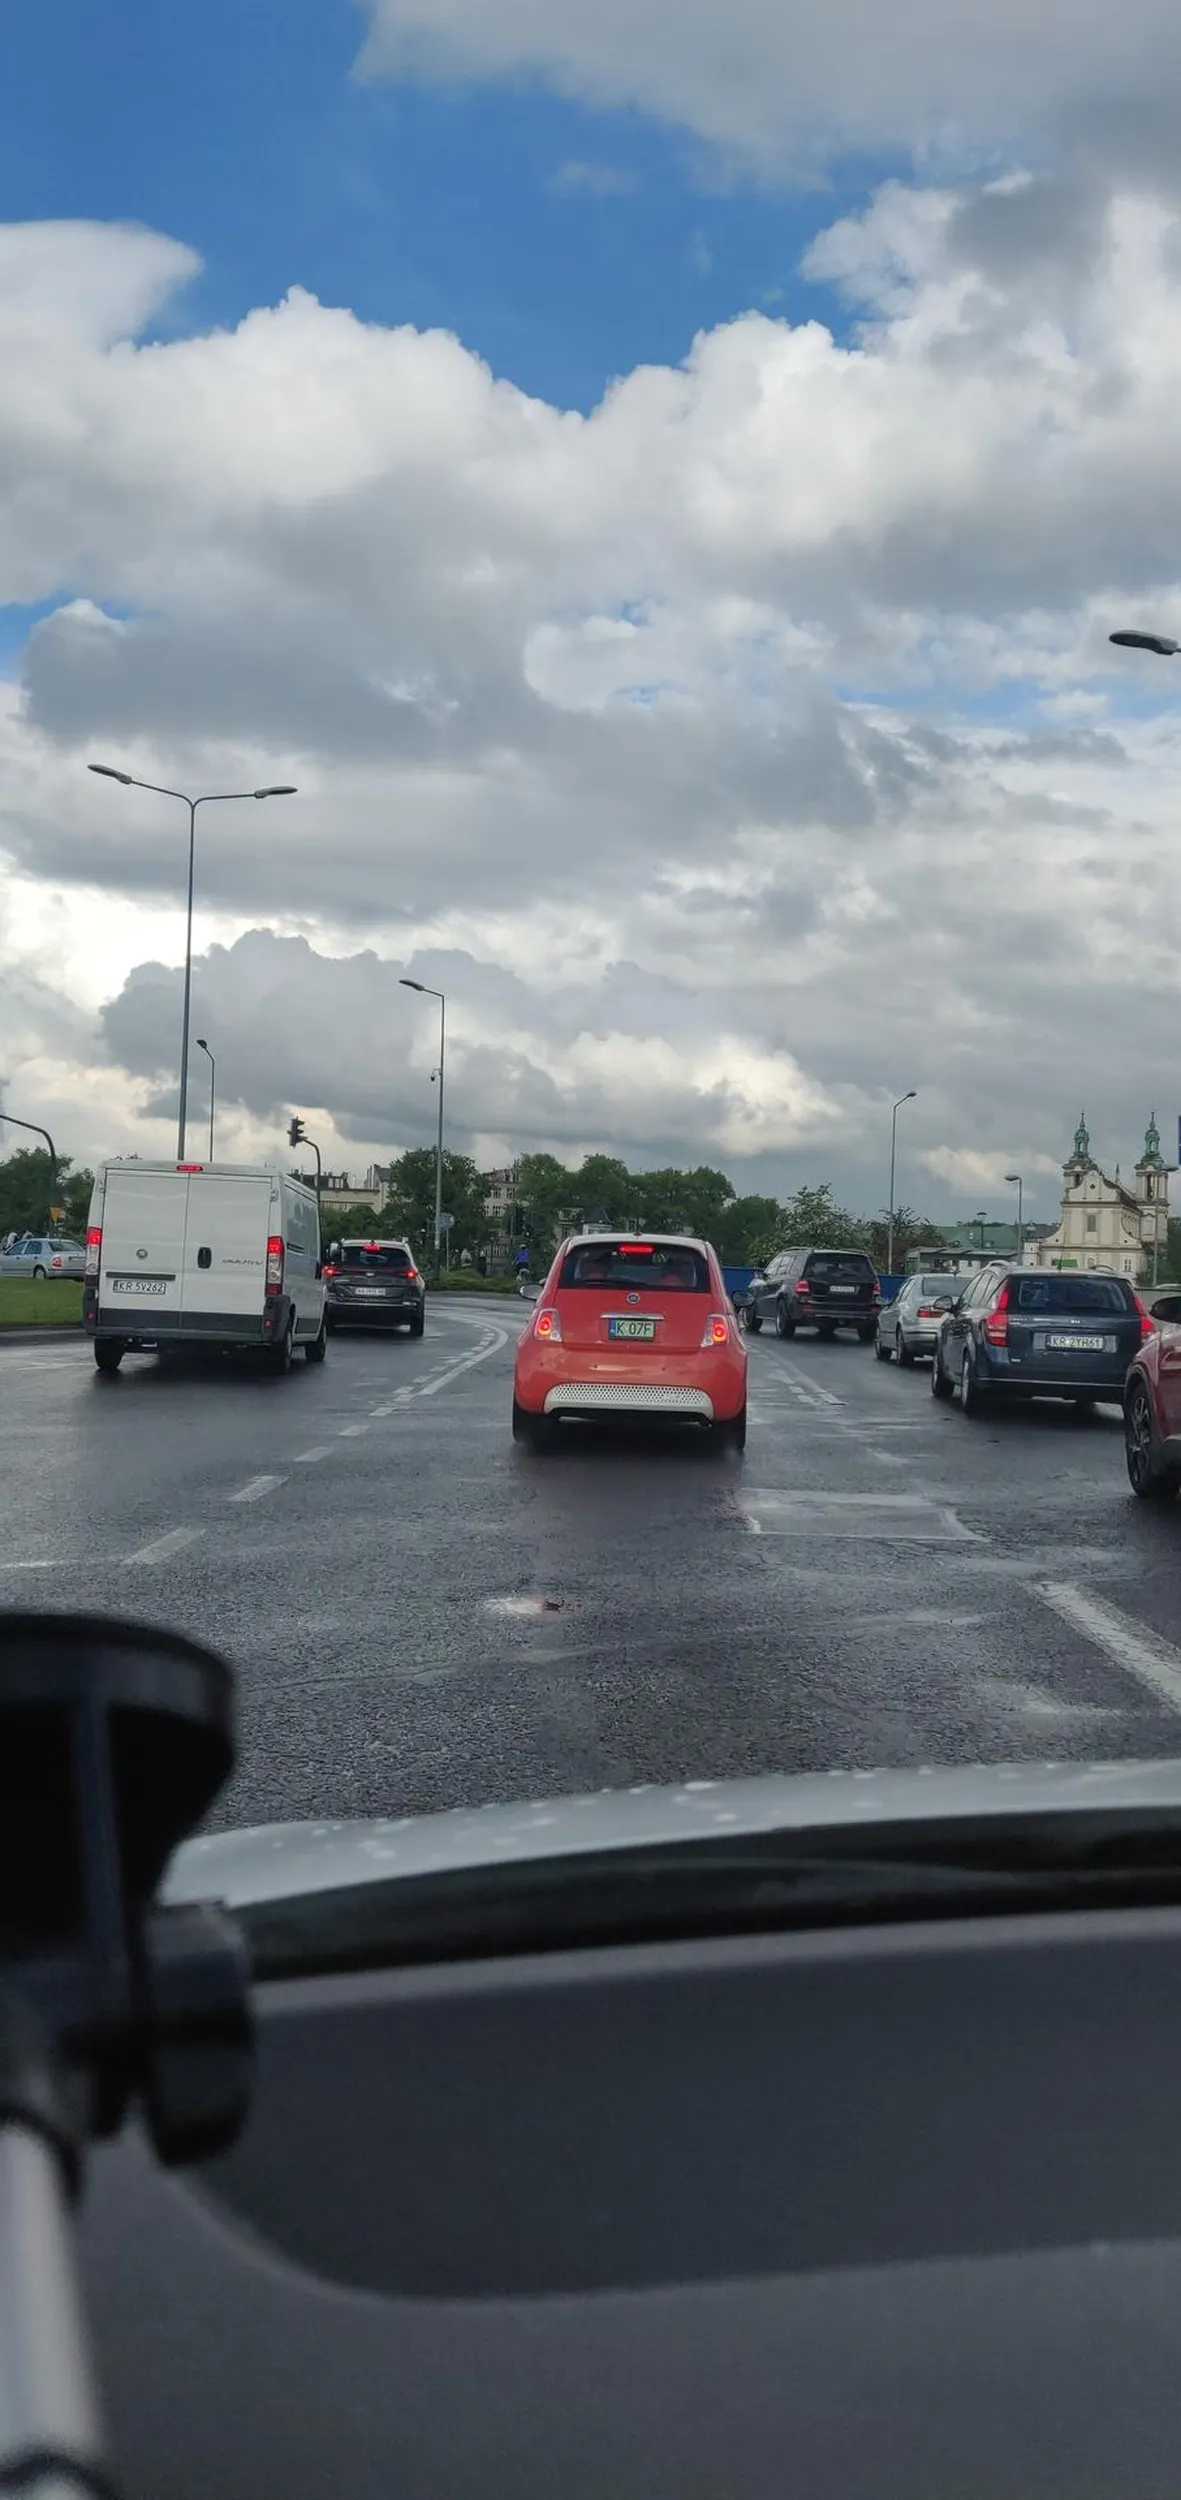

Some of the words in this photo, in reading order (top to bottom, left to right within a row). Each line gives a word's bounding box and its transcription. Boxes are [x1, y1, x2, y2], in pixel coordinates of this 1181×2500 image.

[119, 1282, 132, 1291] KR
[135, 1281, 163, 1292] 5V262
[616, 1322, 625, 1335] K
[629, 1322, 652, 1335] 07F
[1052, 1335, 1066, 1346] KR
